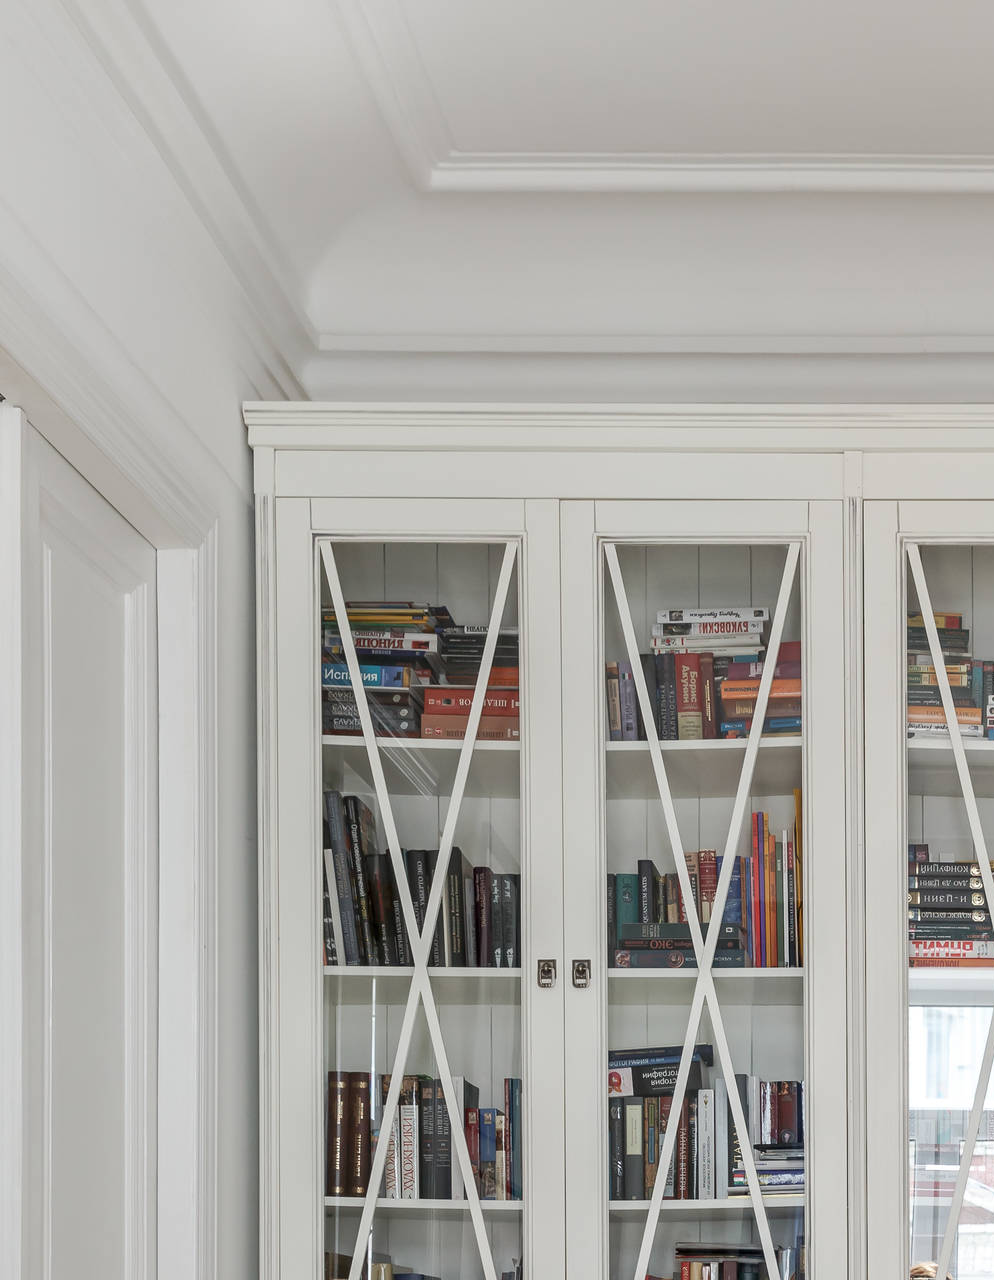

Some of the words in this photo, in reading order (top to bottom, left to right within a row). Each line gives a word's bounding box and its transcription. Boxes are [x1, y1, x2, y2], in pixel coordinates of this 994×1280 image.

[466, 625, 489, 633] НЕАП
[354, 638, 404, 649] ЯПОНИЯ
[324, 668, 378, 681] Испия
[681, 665, 690, 704] Акунин
[689, 671, 698, 703] Борис
[458, 698, 507, 708] ШЕДОВ
[660, 684, 668, 740] КОНЧАТЕЛЬНАЯ
[920, 863, 969, 873] КОНФУЦИЙ
[923, 893, 967, 903] И-ЦЗИН
[650, 940, 674, 950] ЭКО
[642, 1069, 679, 1079] тографии
[651, 1077, 677, 1086] стория
[680, 1128, 688, 1160] ТАЙНАЯ
[403, 1117, 413, 1191] ХУДОЖНИКИ
[386, 1130, 395, 1191] ХУДОЖНИ
